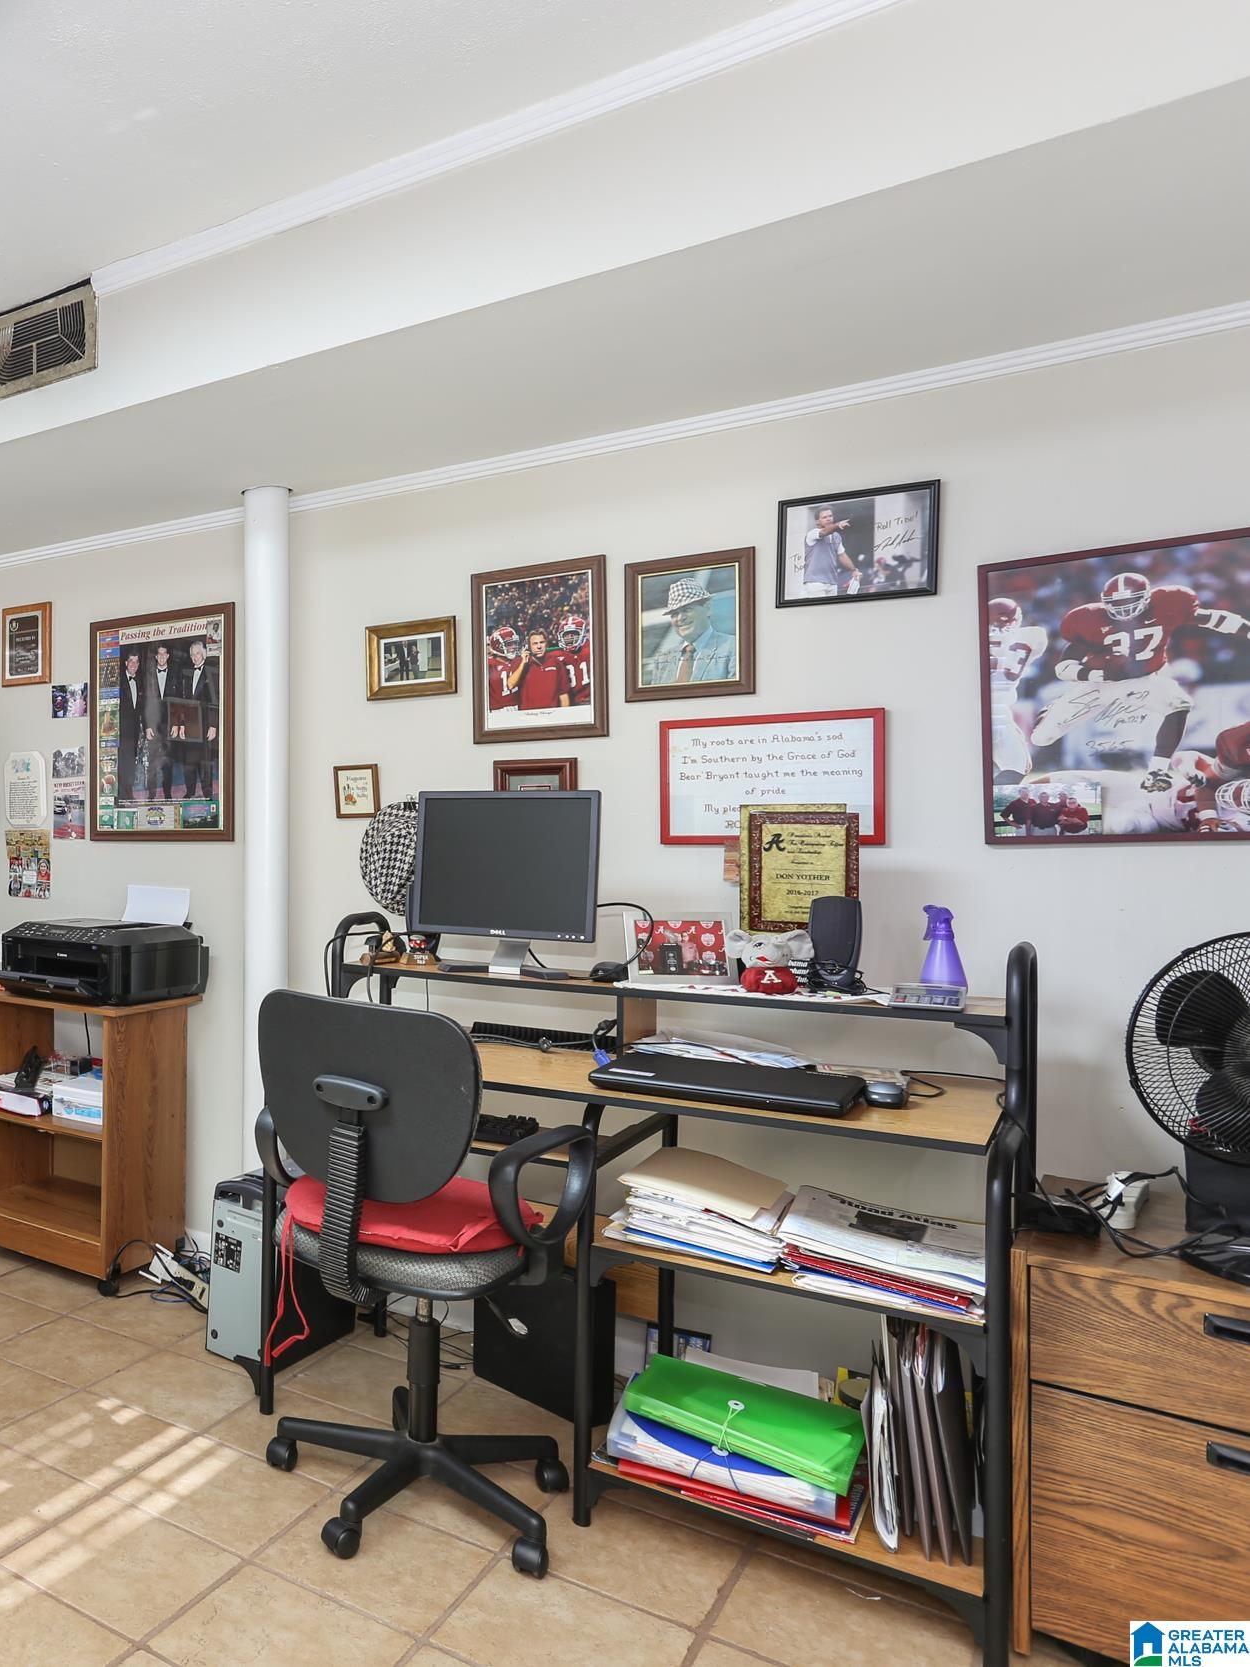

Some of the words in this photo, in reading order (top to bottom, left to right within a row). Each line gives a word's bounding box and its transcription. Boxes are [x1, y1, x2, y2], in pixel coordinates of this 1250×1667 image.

[120, 629, 151, 641] Passing
[152, 627, 166, 637] the
[169, 621, 208, 635] Tradition
[1103, 625, 1164, 661] 37
[692, 738, 707, 749] My
[710, 738, 735, 746] roots
[757, 736, 767, 744] in
[701, 754, 748, 764] Southern
[751, 754, 763, 764] by
[767, 752, 784, 761] the
[787, 751, 817, 761] Grace
[820, 750, 833, 760] of
[837, 749, 856, 759] God
[706, 770, 740, 782] Bryant
[743, 769, 780, 781] taught
[800, 768, 818, 777] the
[822, 766, 863, 778] meaning
[745, 787, 757, 796] of
[760, 786, 787, 797] pride
[704, 804, 720, 815] My
[795, 873, 831, 881] YOTHER
[785, 888, 819, 897] 2016-2017
[760, 969, 782, 984] A
